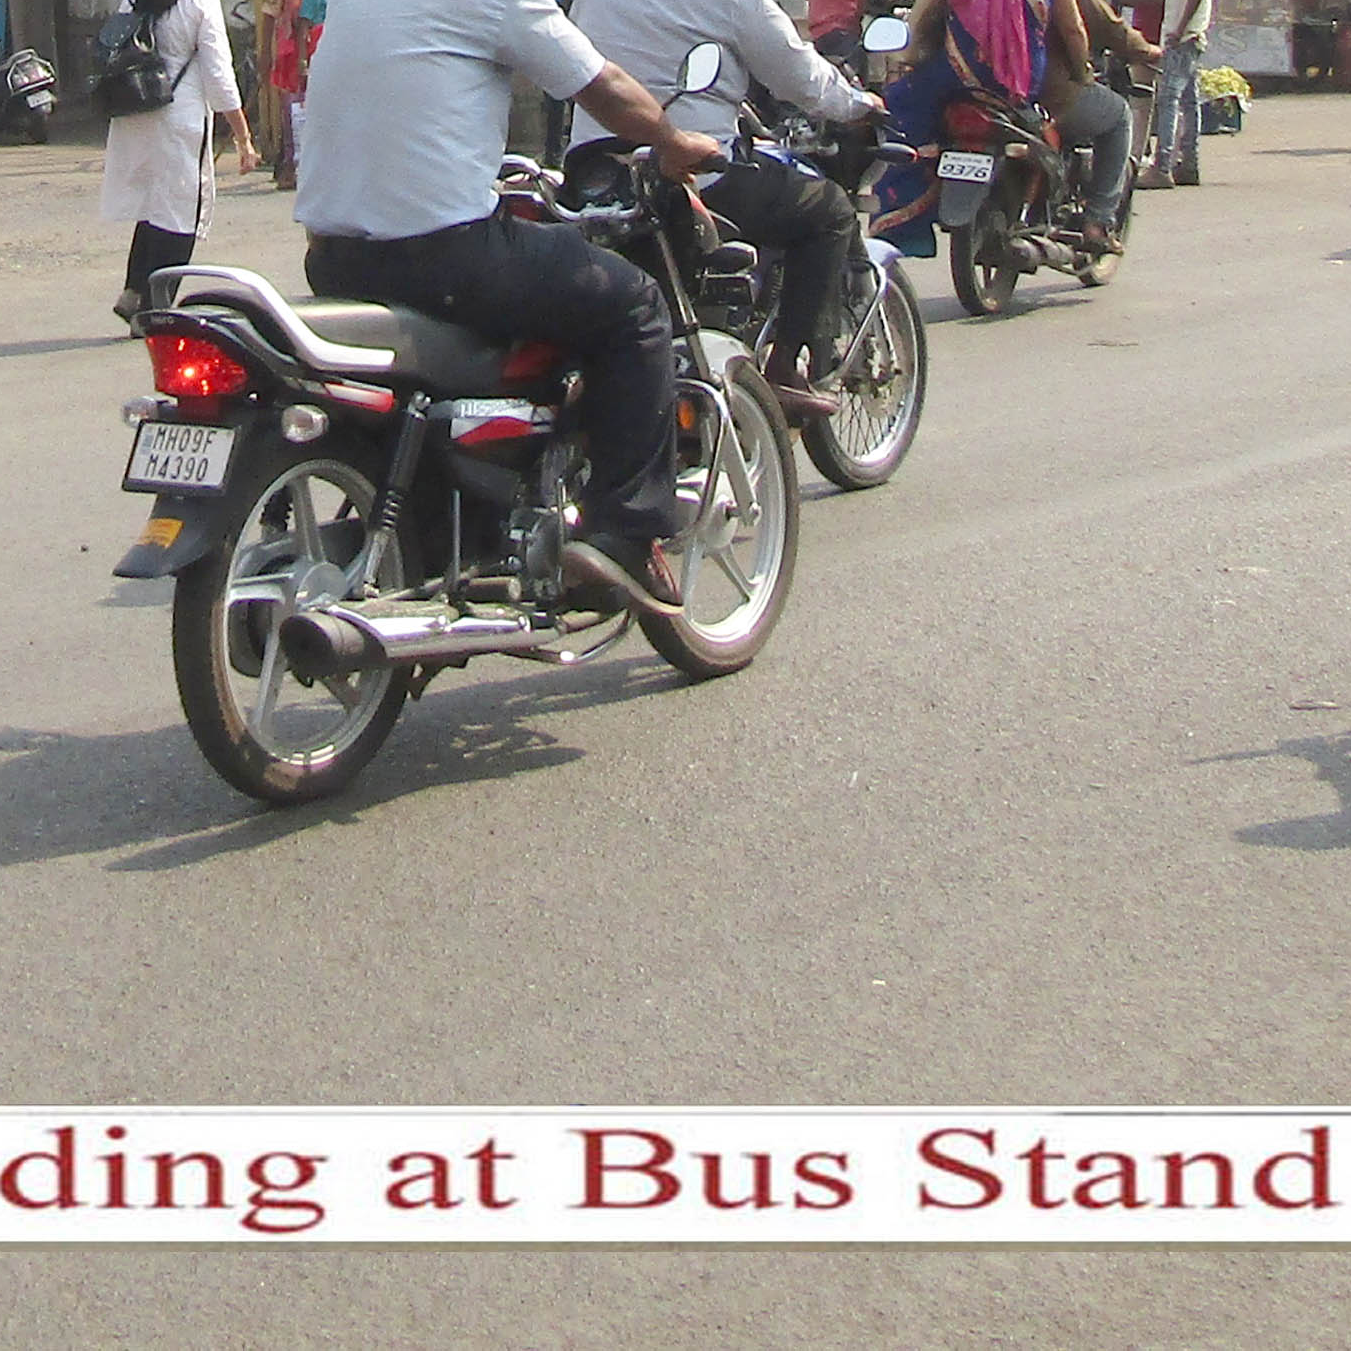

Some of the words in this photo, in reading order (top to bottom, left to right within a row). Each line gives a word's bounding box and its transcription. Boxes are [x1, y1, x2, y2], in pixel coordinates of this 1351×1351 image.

[941, 164, 989, 179] 9376
[151, 426, 218, 456] MH09F
[144, 456, 210, 483] M4390
